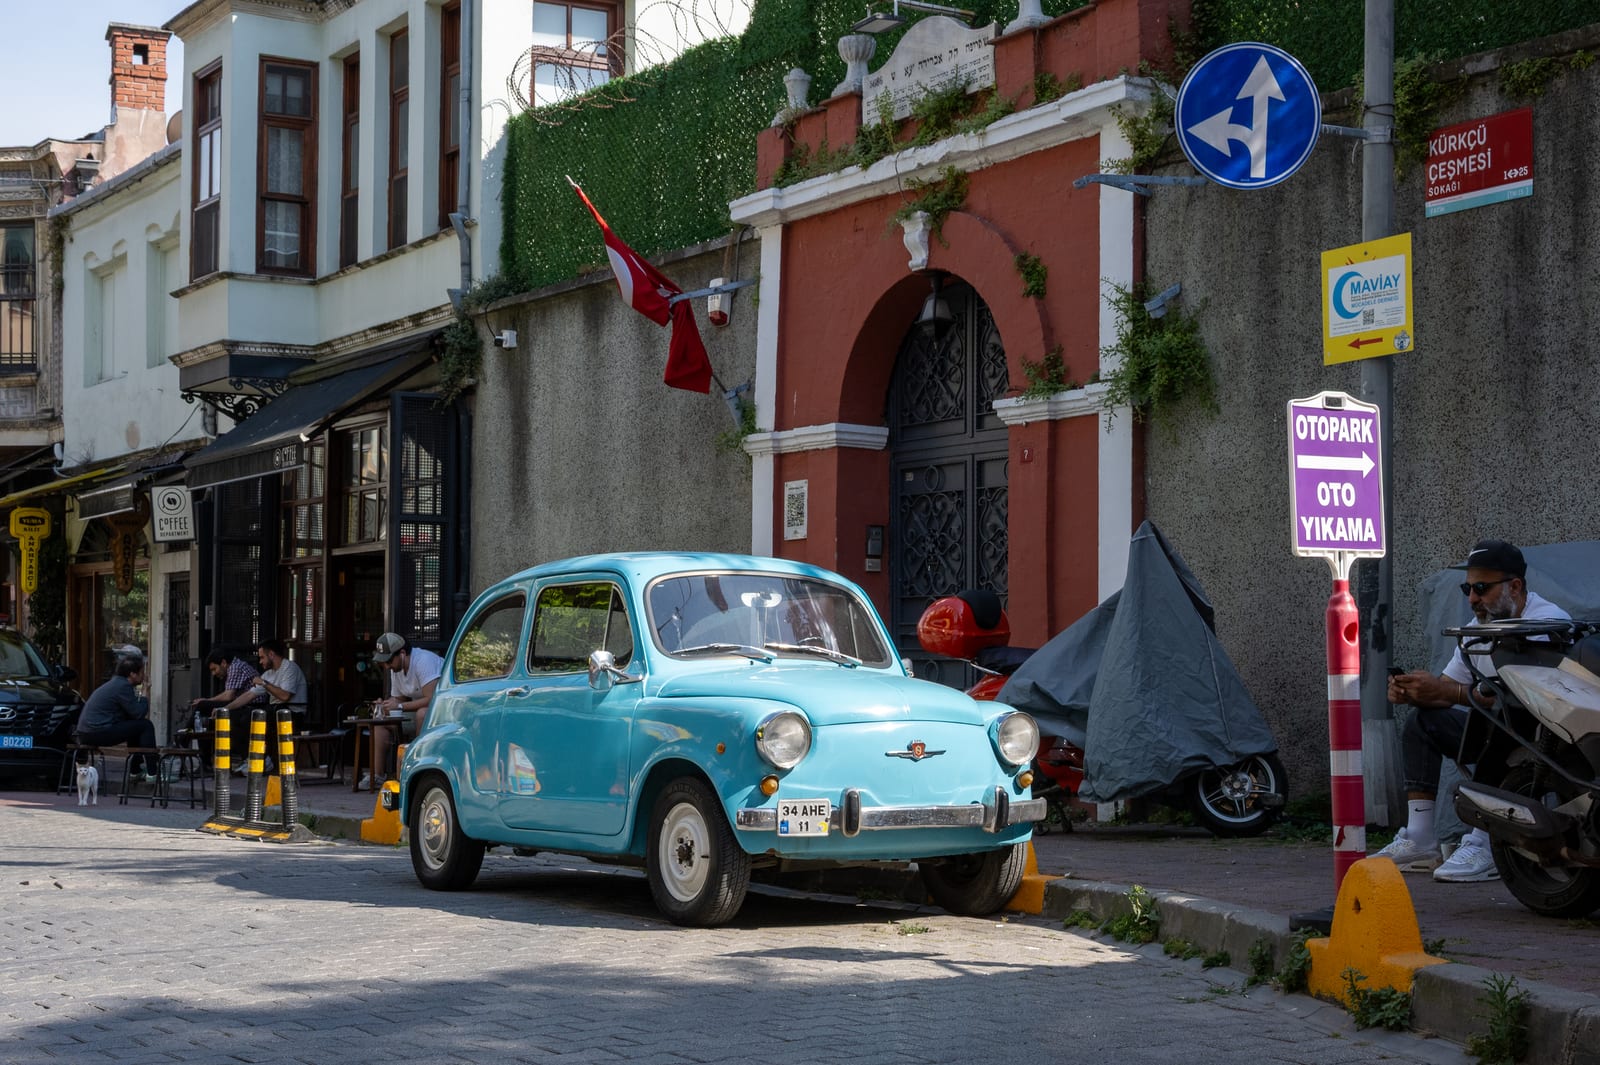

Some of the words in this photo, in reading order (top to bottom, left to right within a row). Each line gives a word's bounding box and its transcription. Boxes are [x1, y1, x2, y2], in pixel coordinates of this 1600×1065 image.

[1429, 124, 1487, 157] KÜRKÇÜ
[1428, 148, 1492, 184] ÇEŞMESİ
[1518, 166, 1529, 177] 25
[1428, 181, 1460, 196] SOKAĞI
[1350, 273, 1401, 295] MAVİAY
[1295, 414, 1374, 443] OTOPARK
[1317, 481, 1356, 507] OTO
[159, 516, 189, 531] COFFEE
[1300, 516, 1377, 542] YIKAMA
[782, 805, 798, 817] 34
[801, 805, 826, 816] AHE
[798, 820, 809, 832] 11
